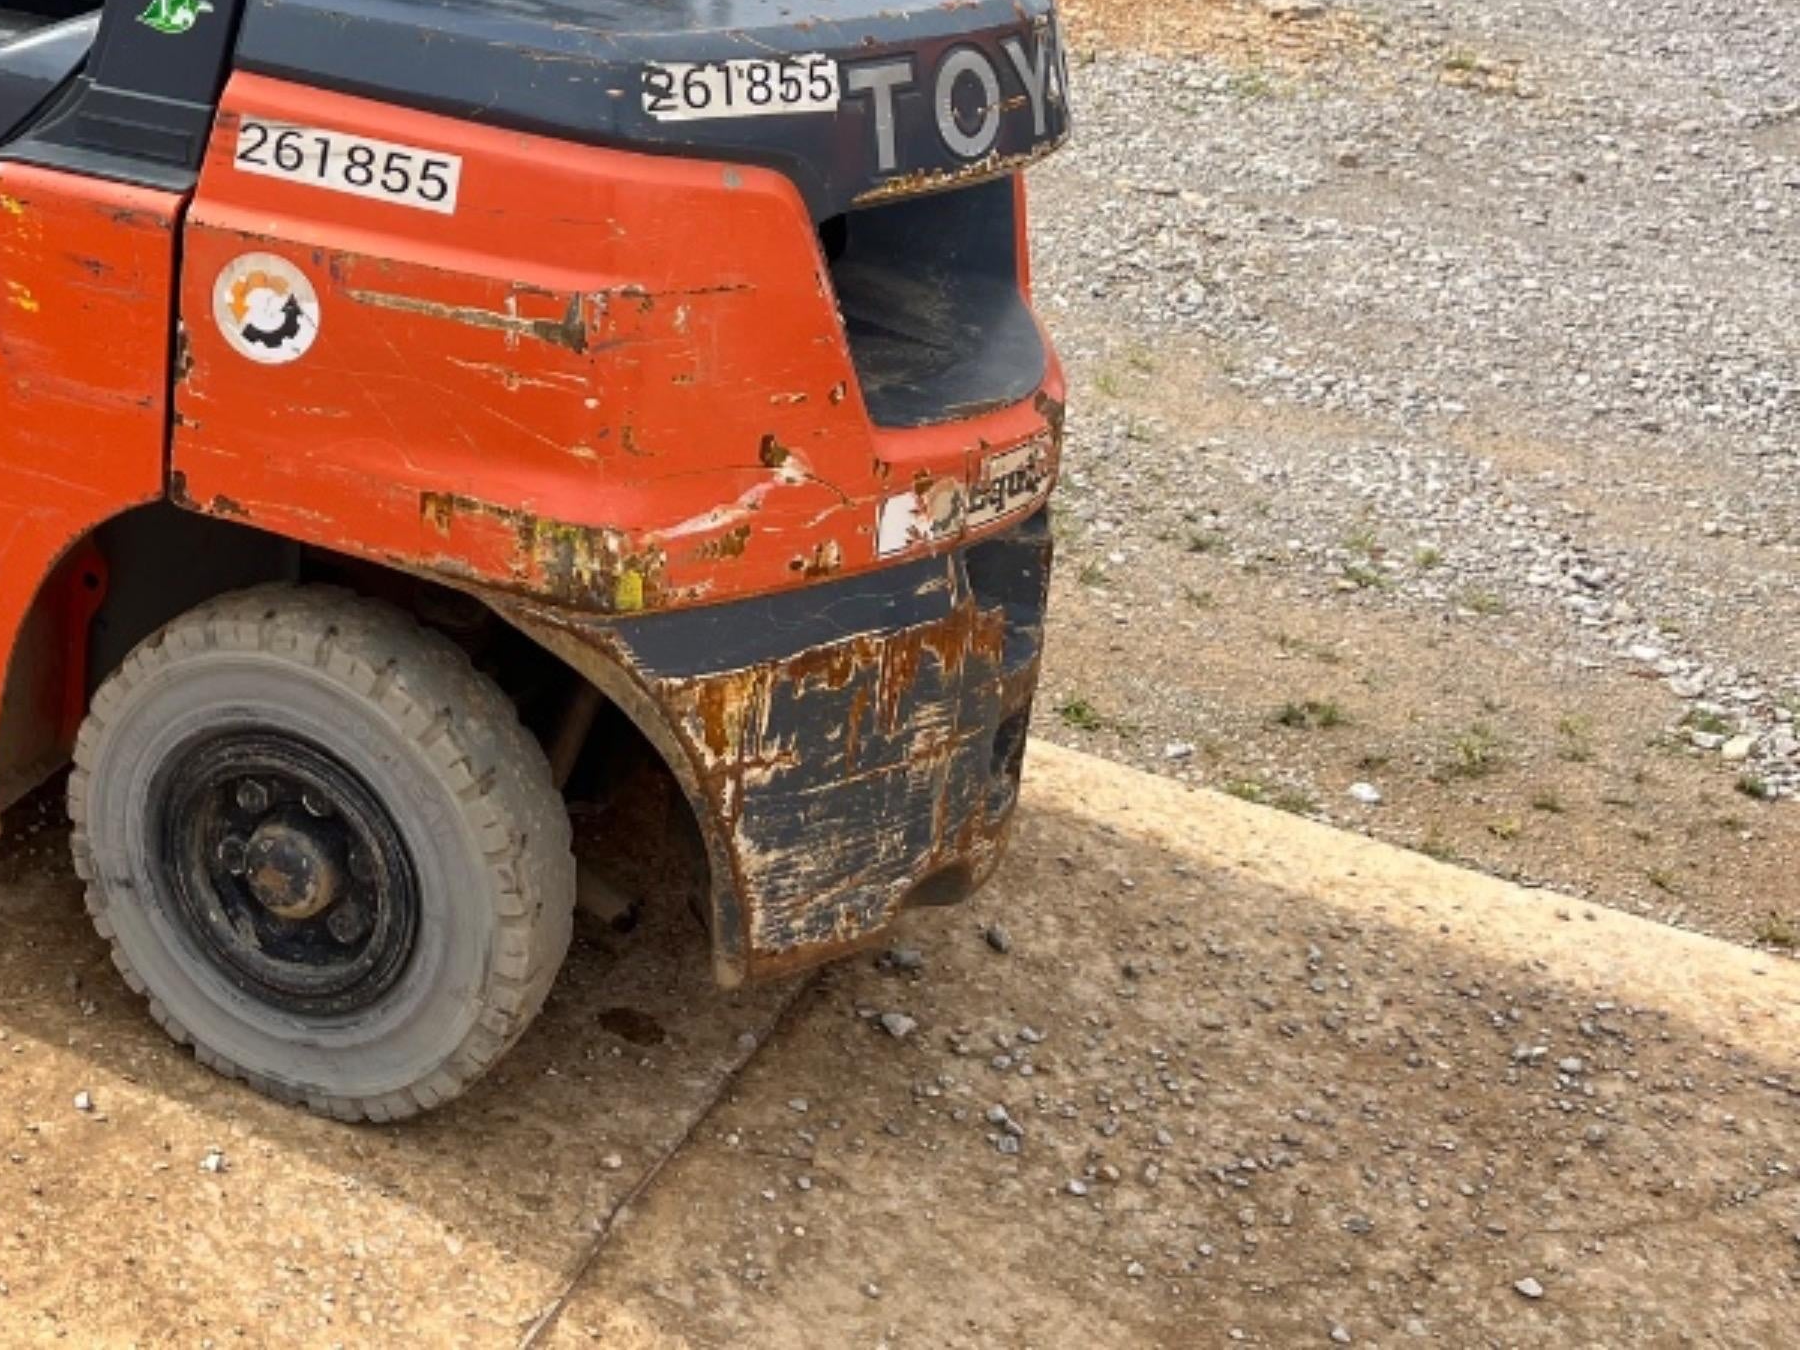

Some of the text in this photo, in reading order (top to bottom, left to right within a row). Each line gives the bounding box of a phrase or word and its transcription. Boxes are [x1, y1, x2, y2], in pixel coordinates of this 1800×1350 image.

[645, 60, 834, 113] 261855
[848, 40, 1067, 171] TOY
[236, 122, 452, 203] 261855
